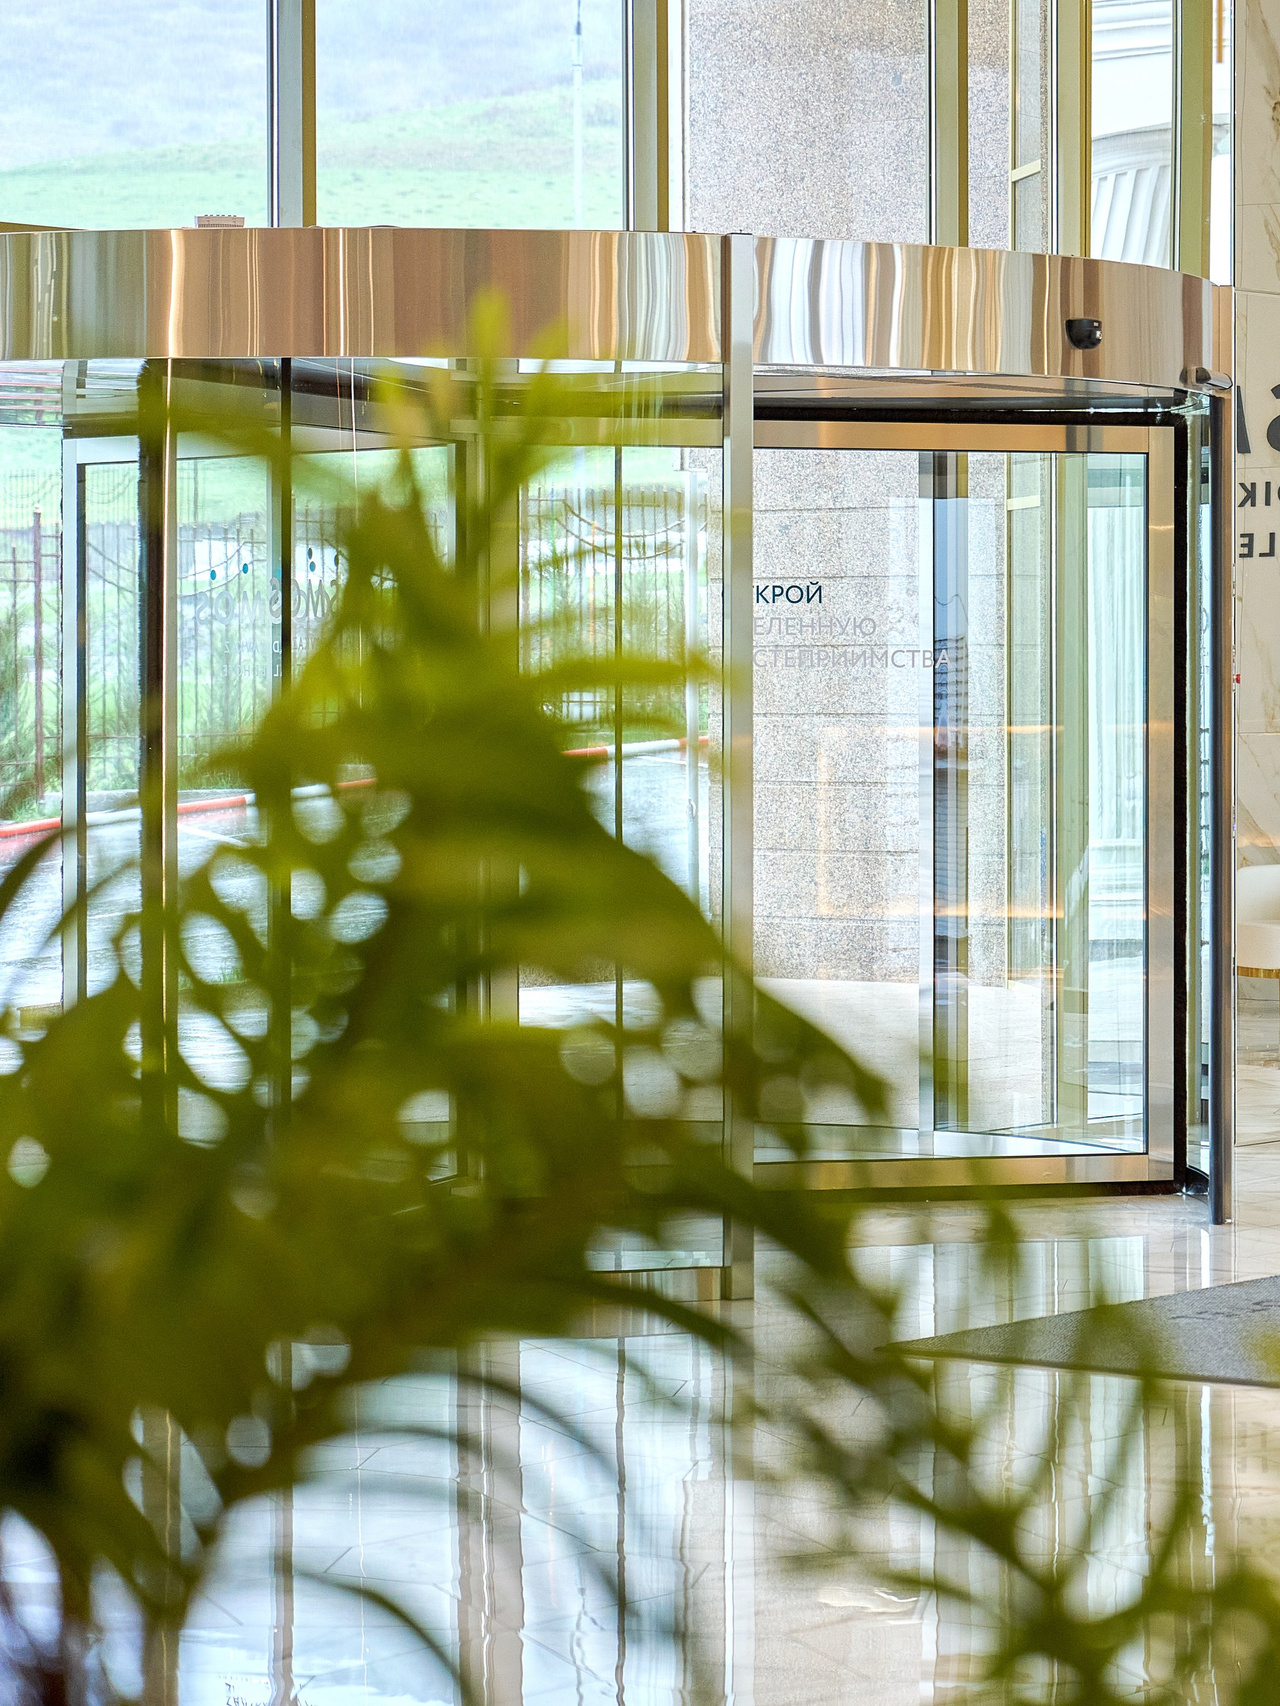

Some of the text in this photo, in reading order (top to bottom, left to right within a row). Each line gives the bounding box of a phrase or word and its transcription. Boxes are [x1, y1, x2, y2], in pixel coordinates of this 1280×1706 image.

[752, 582, 823, 604] КРОЙ
[753, 616, 877, 637] ЕЛЕННУЮ
[753, 649, 951, 669] СТЕПРИИМСТВА
